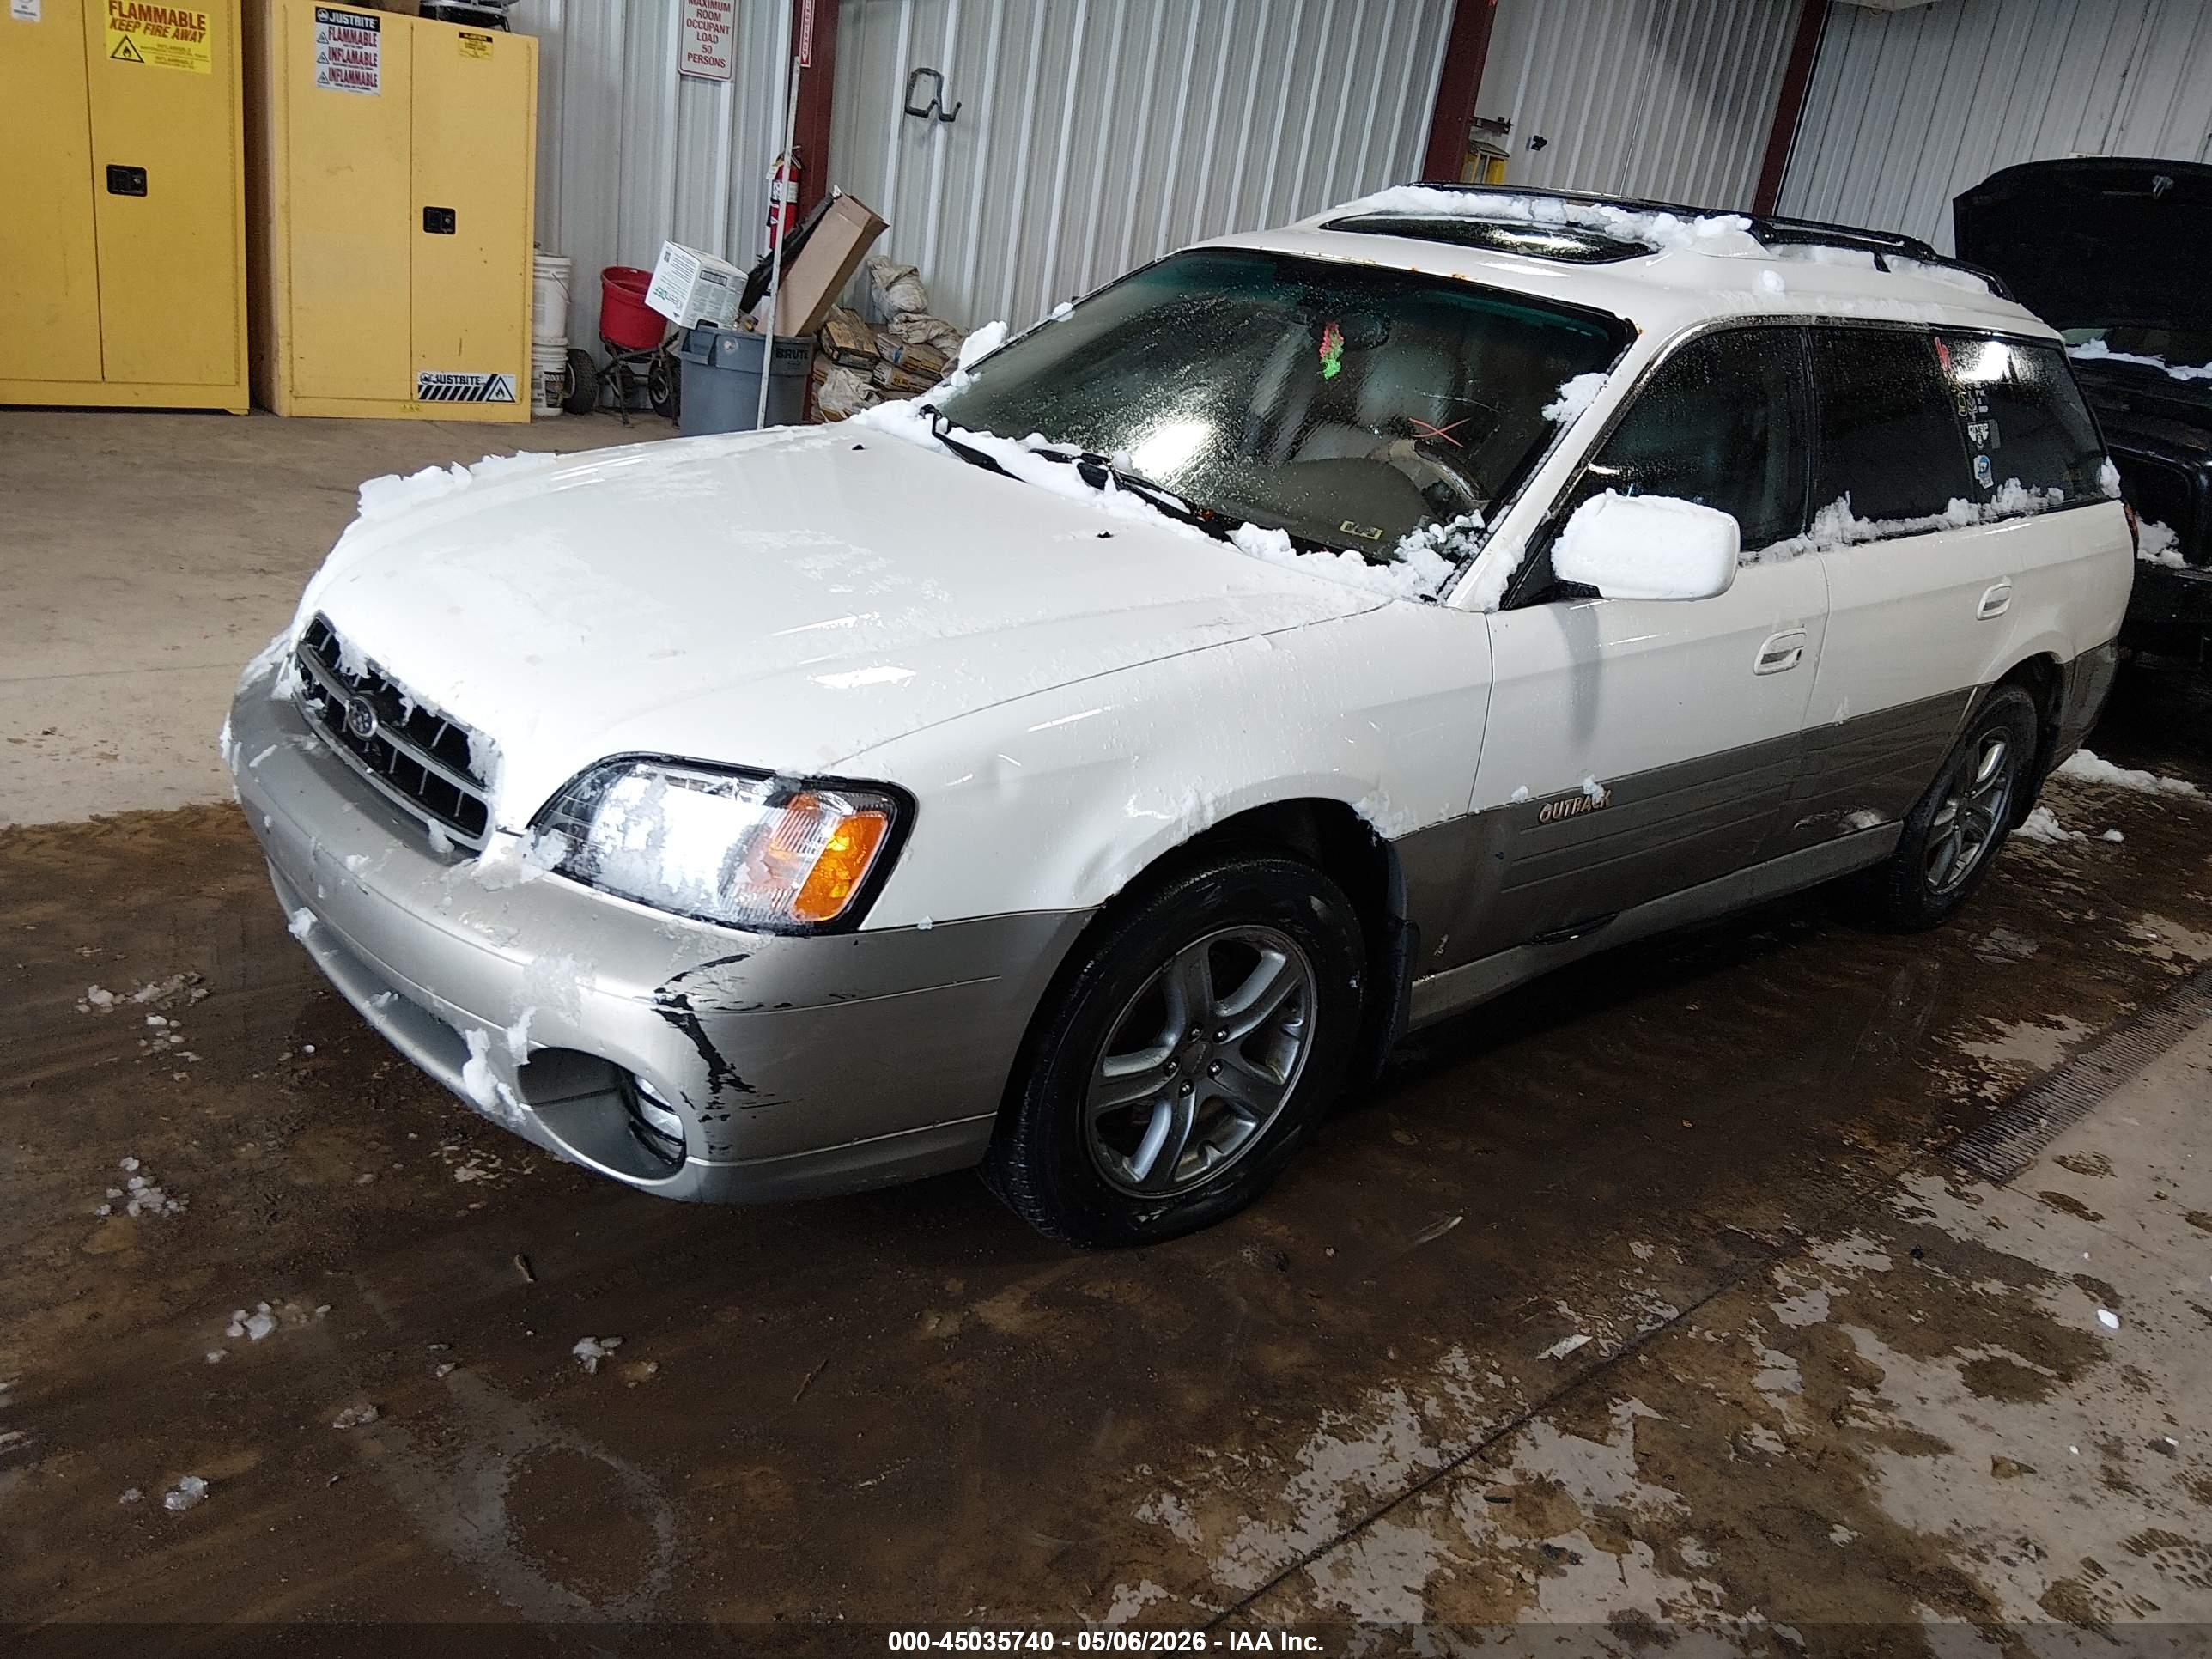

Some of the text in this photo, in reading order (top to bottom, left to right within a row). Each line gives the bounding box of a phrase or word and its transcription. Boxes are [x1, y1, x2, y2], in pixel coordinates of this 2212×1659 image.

[687, 0, 731, 12] MAXIMUM
[108, 0, 206, 31] FLAMMABLE
[329, 11, 375, 28] JUSTRITE
[696, 9, 722, 21] ROOM
[109, 17, 206, 43] KEEP FIRE AWAY
[686, 18, 731, 35] OCCUPANT
[328, 26, 378, 47] FLAMMABLE
[696, 31, 719, 44] LOAD
[328, 46, 378, 68] INFLAMABLE
[702, 44, 713, 54] 50
[687, 52, 726, 69] PERSONS
[328, 67, 379, 88] INFLAMMABLE
[775, 347, 809, 360] BRUTE
[434, 374, 482, 386] JUSTRITE
